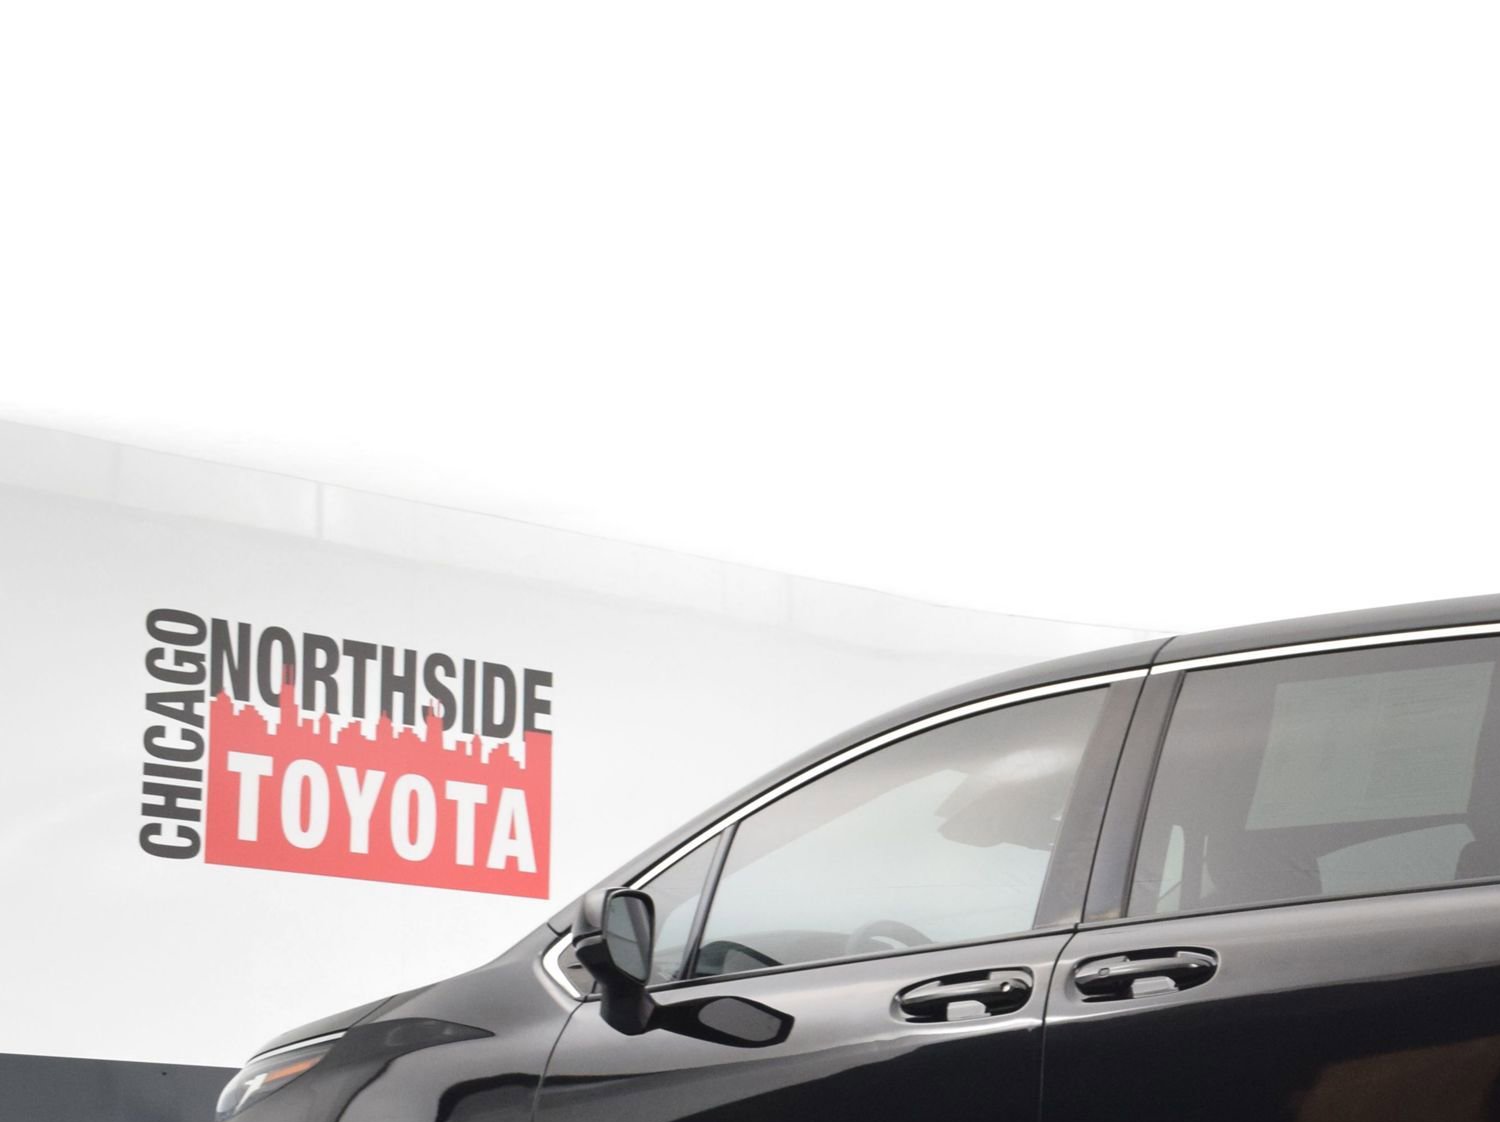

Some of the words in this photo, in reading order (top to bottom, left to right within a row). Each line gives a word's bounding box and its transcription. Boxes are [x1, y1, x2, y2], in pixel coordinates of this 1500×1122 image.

[139, 608, 207, 860] CHICAGO
[210, 617, 553, 740] NORTHSIDE
[227, 750, 537, 873] TOYOTA
